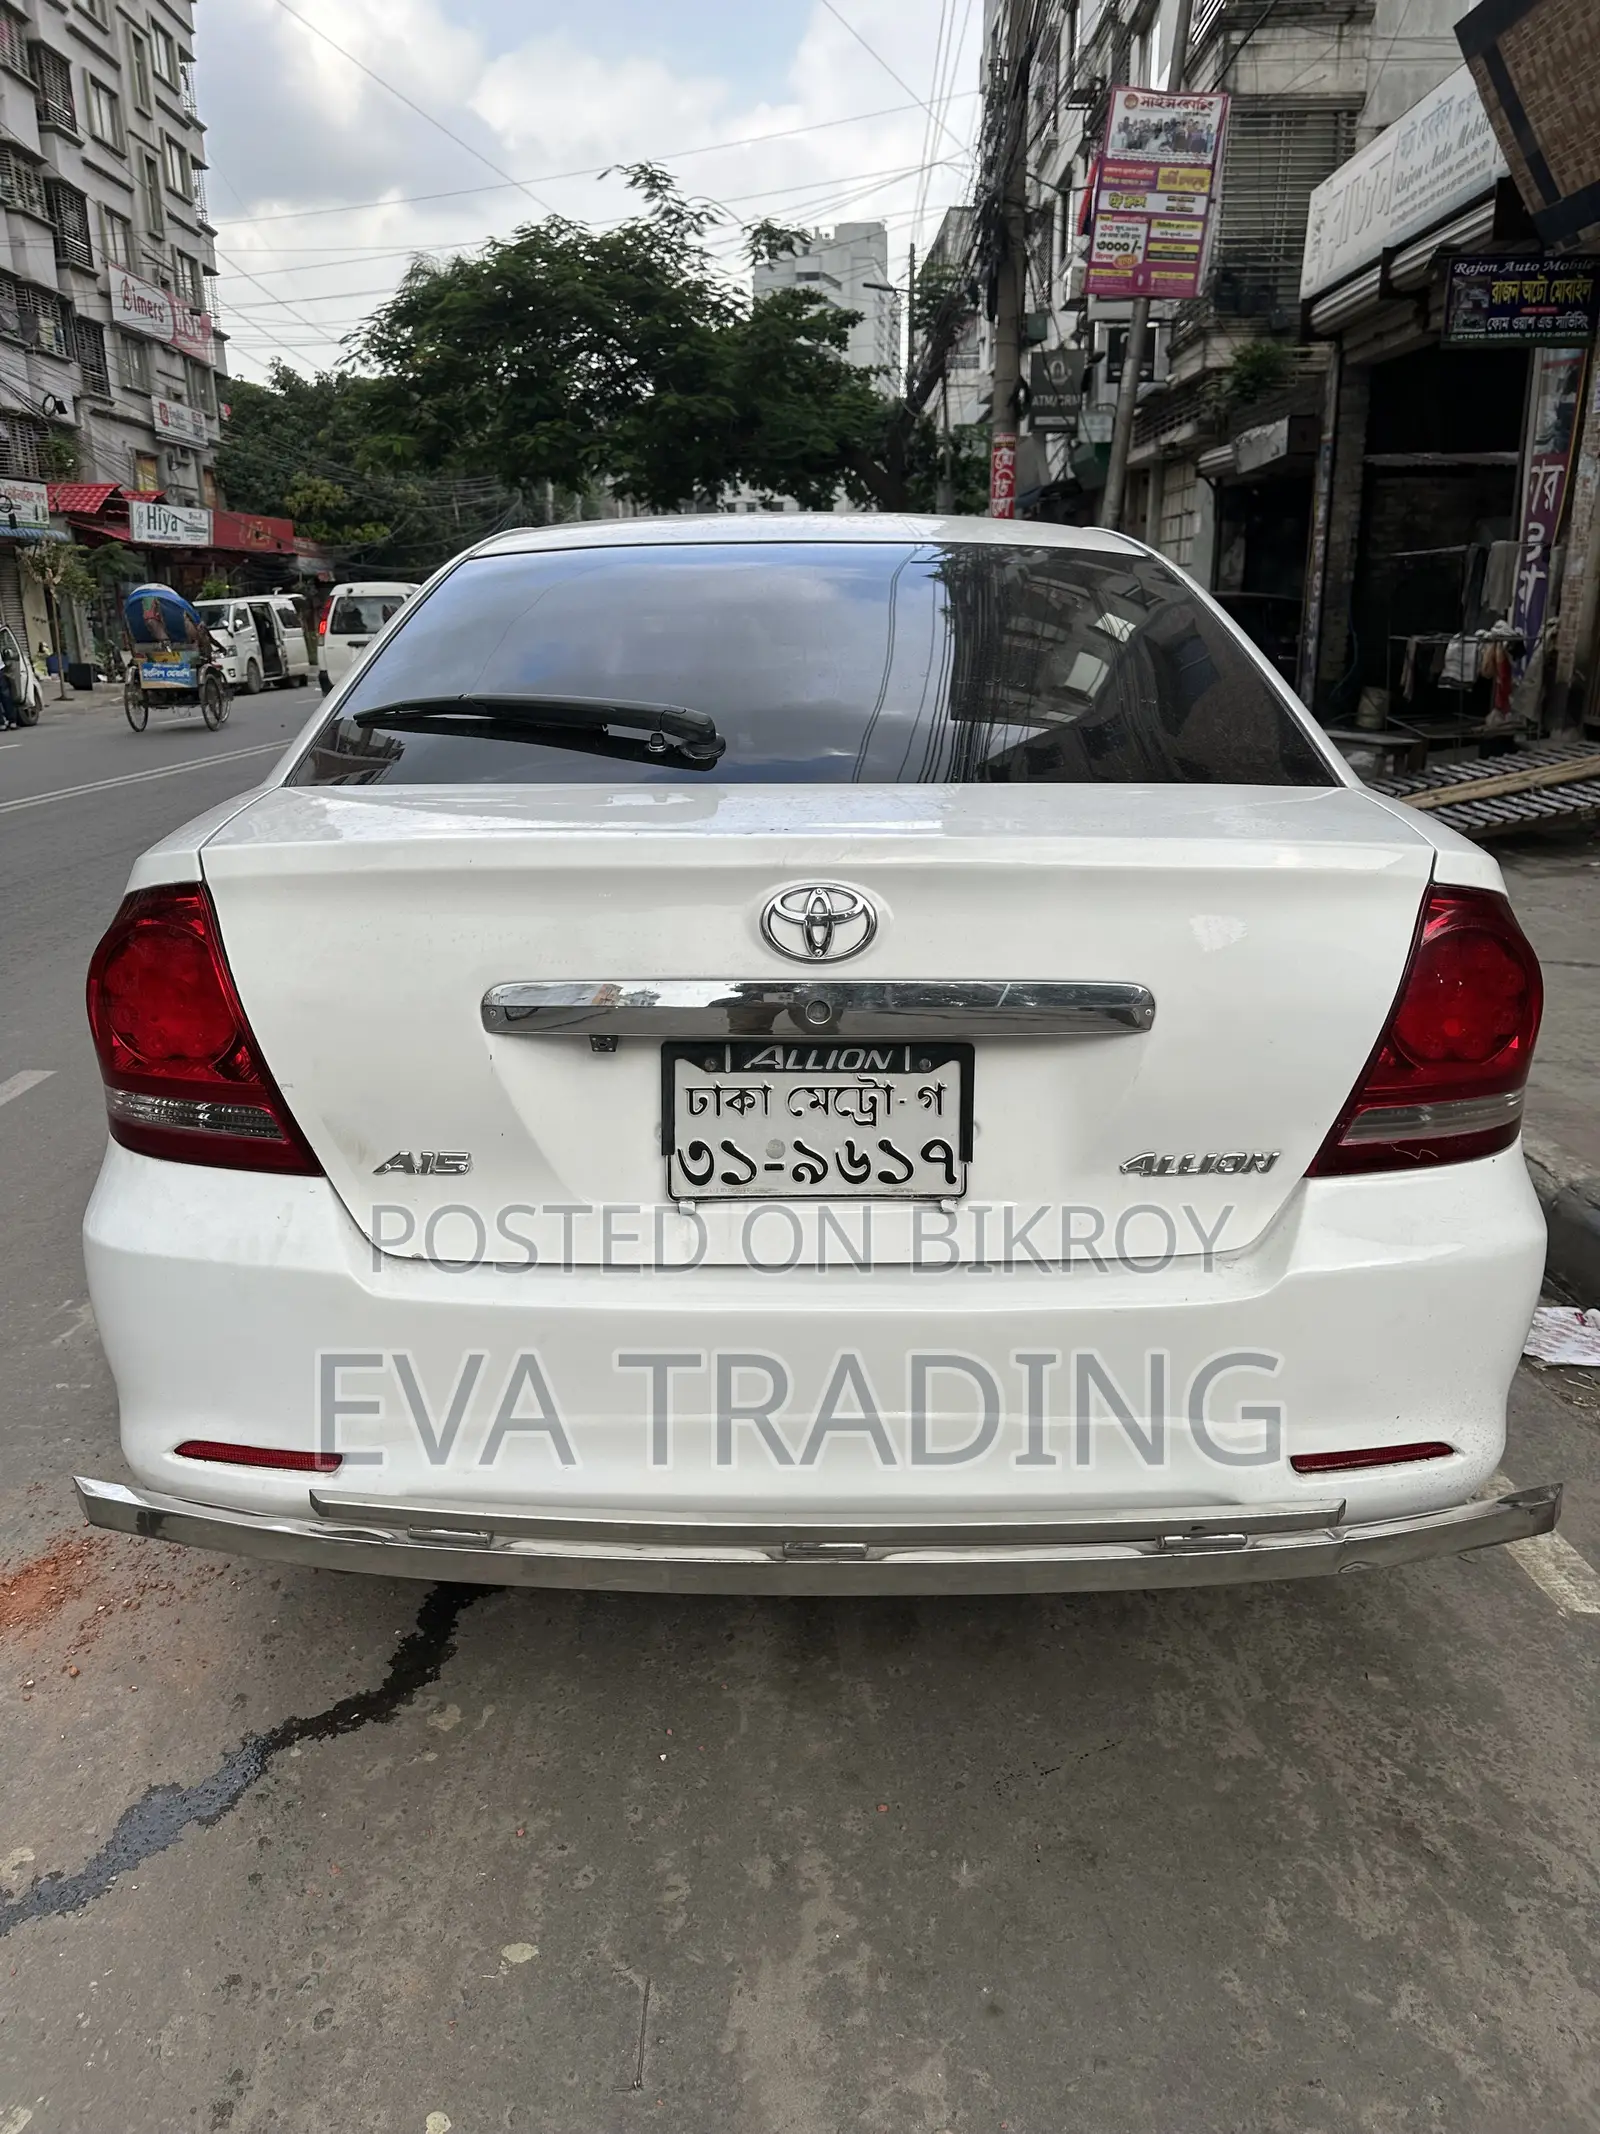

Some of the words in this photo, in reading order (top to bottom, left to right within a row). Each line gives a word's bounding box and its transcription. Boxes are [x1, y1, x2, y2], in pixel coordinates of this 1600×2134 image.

[1454, 262, 1498, 276] Rajon
[1498, 261, 1541, 273] Auto
[147, 505, 179, 534] Hiya
[743, 1044, 894, 1070] ALLION
[684, 1081, 774, 1117] ঢাকা
[677, 1137, 957, 1186] ৩১-৯৬১৭
[1119, 1150, 1281, 1176] ALLION
